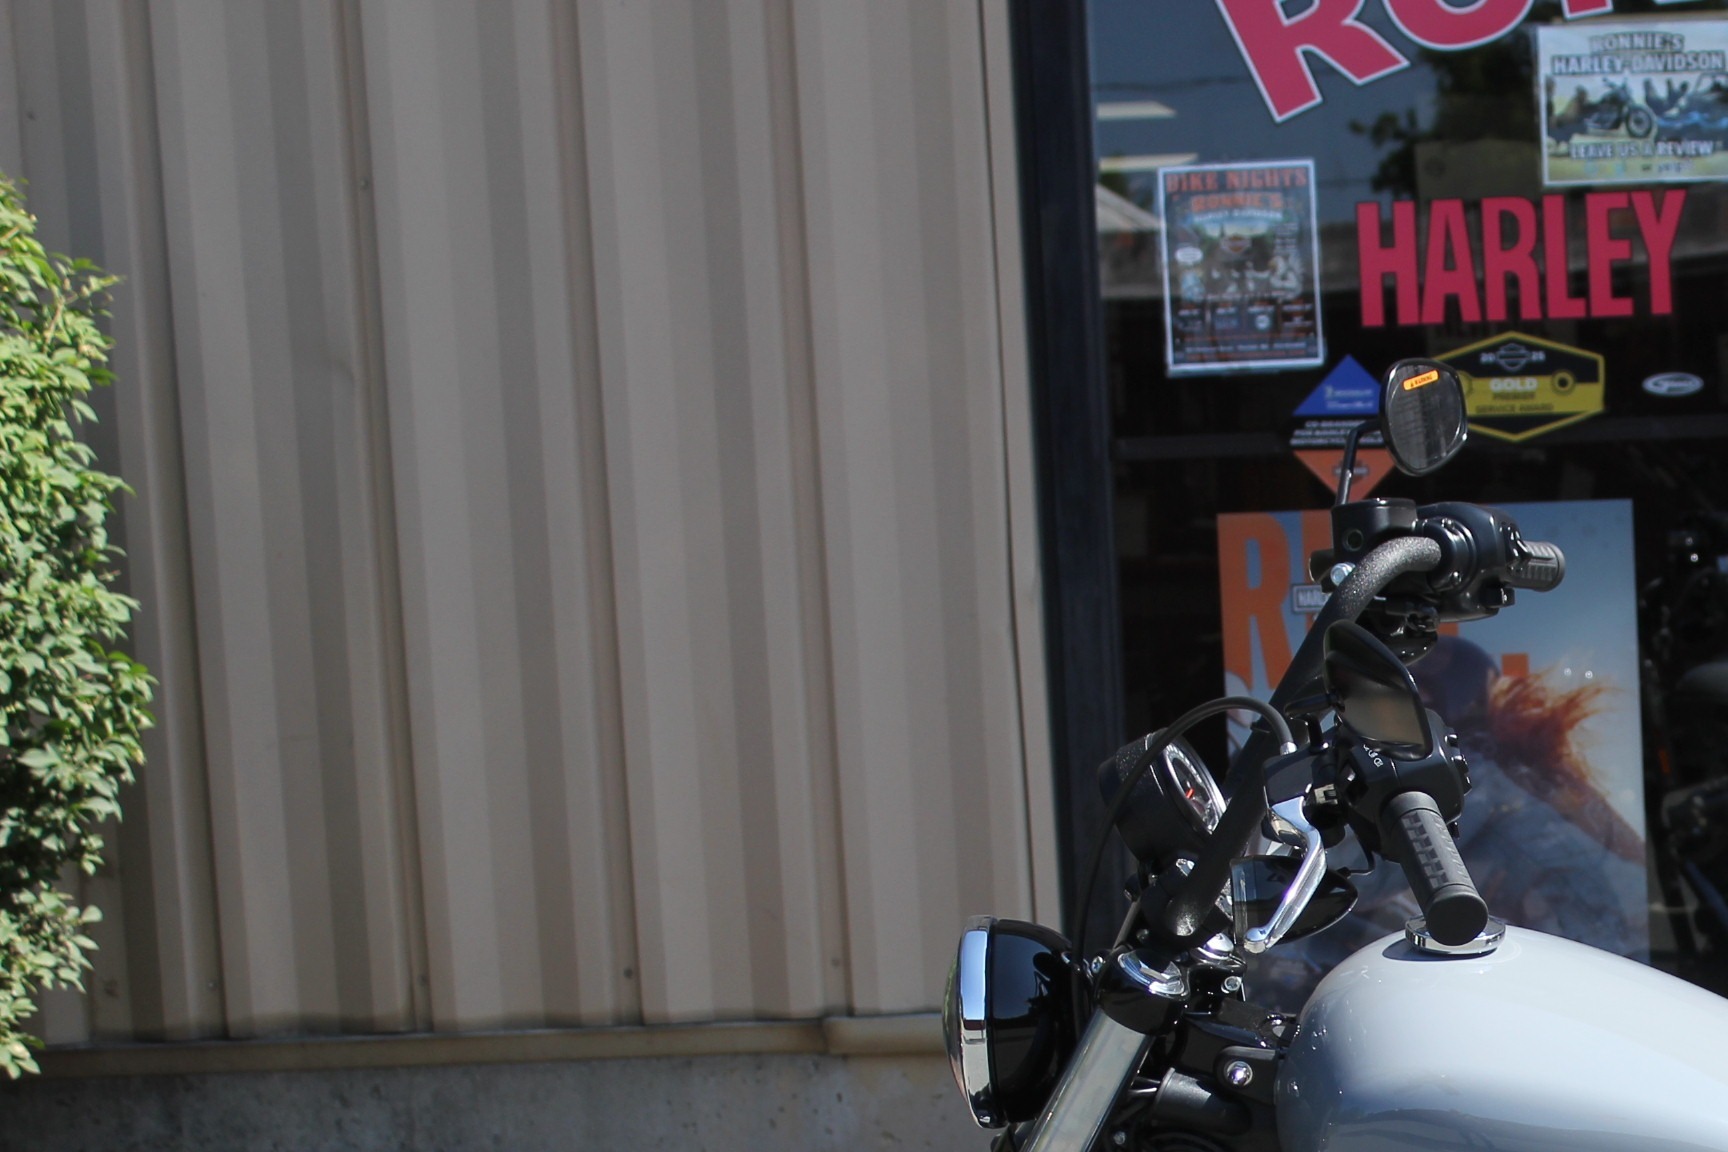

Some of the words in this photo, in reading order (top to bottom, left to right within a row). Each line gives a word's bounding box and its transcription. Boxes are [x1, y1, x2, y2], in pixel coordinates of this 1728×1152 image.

[1589, 32, 1685, 51] RONNIE'S
[1552, 50, 1726, 75] HARLEY-DAVIDSON
[1617, 142, 1637, 158] US
[1656, 140, 1714, 157] REVIEW
[1356, 189, 1687, 327] HARLEY
[1490, 377, 1537, 391] GOLD
